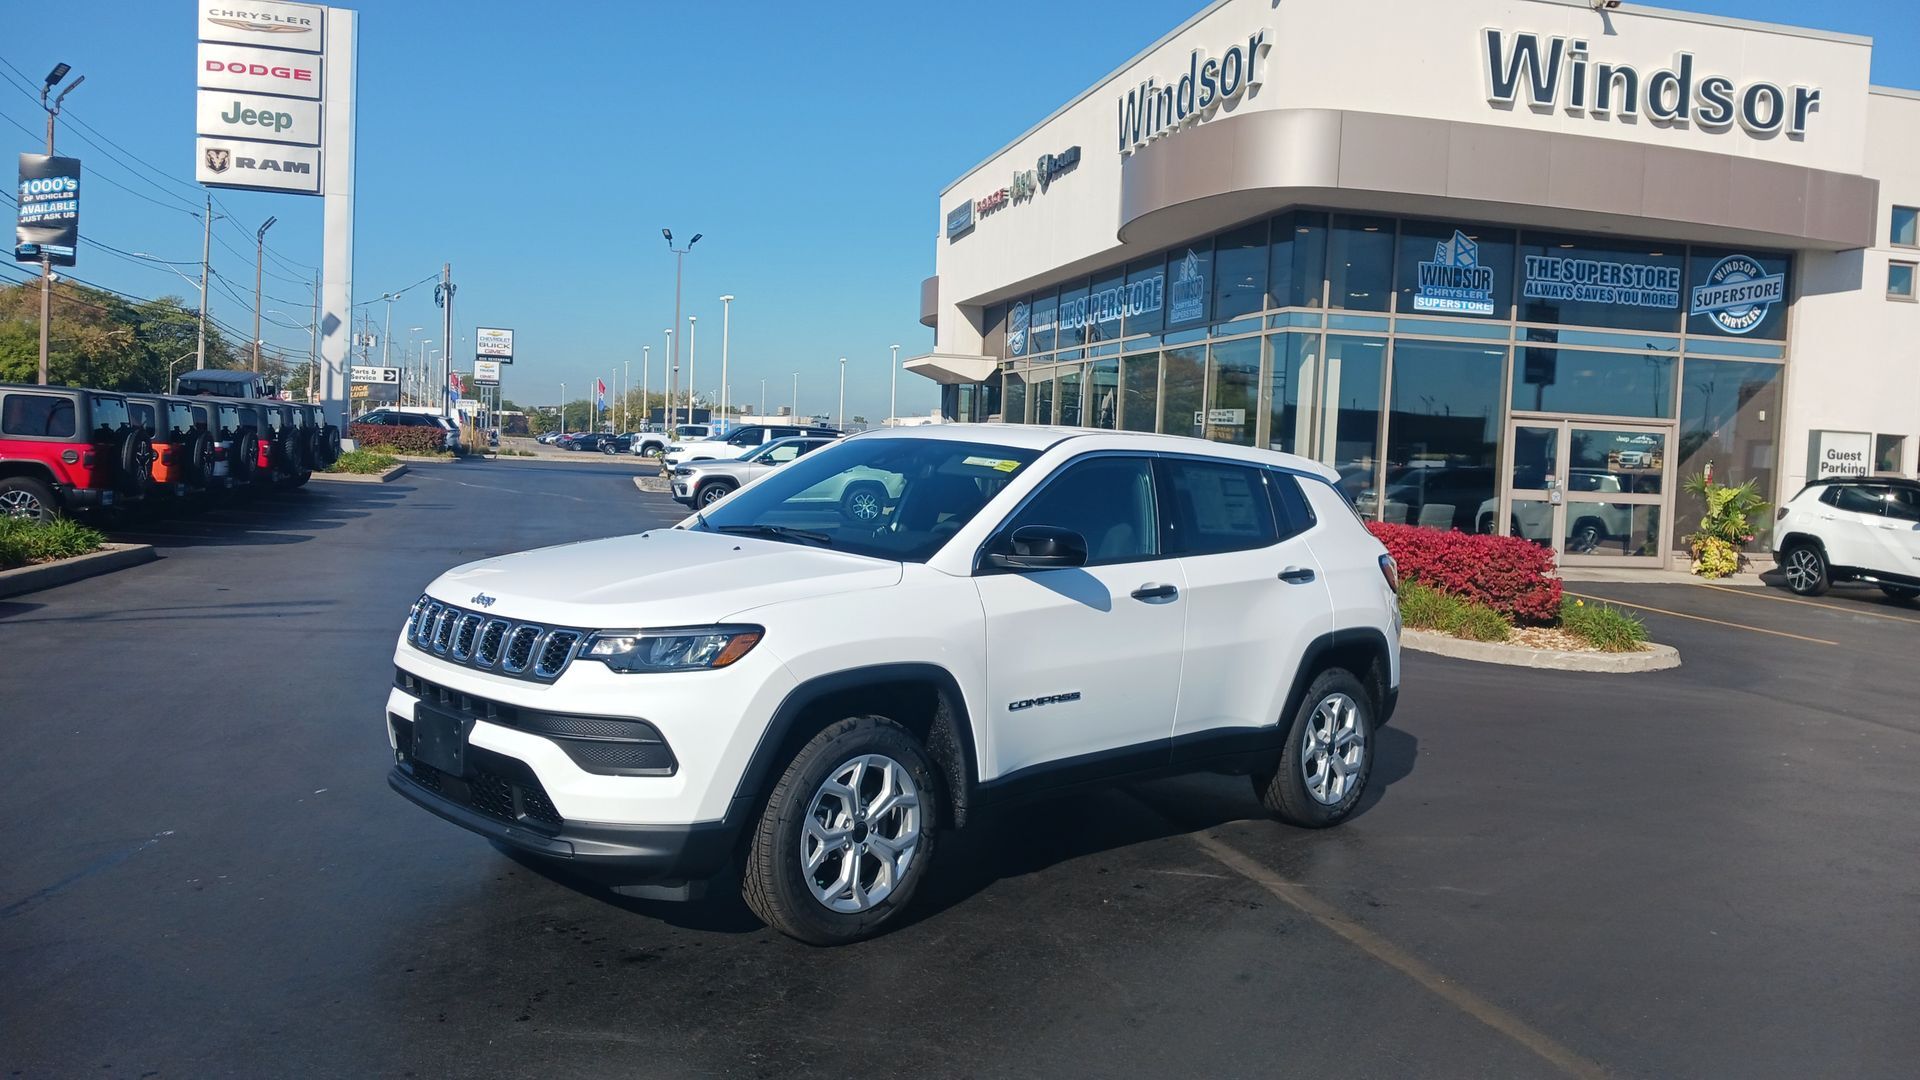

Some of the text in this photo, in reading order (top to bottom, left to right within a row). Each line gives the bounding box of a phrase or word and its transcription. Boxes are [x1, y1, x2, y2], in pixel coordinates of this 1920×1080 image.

[209, 9, 311, 26] CHRYSLER
[206, 60, 312, 81] DODGE
[1117, 26, 1274, 155] Windsor
[1482, 28, 1822, 135] Windsor
[221, 101, 293, 132] Jeep
[235, 156, 310, 174] RAM
[22, 178, 77, 194] 1000's
[35, 192, 74, 201] VEHICLES
[21, 202, 76, 215] AVAILABLE
[21, 214, 42, 223] JUST
[43, 212, 61, 220] ASK
[1420, 265, 1491, 290] WINDSOR
[1526, 257, 1679, 290] THE SUPERSTORE
[1714, 260, 1757, 281] WINDSOR
[1075, 275, 1163, 328] SUPERSTORE
[1418, 297, 1491, 311] SUPERSTORE
[1426, 287, 1483, 300] CHRYSLER
[1525, 281, 1678, 307] ALWAYS SAVES YOU MORE!
[1695, 281, 1780, 307] SUPERSTORE
[1719, 306, 1762, 329] CHRYSLER
[1827, 448, 1862, 461] Guest
[1821, 461, 1866, 477] Parking
[471, 592, 497, 608] Jeep
[1008, 691, 1081, 712] COMPASS
